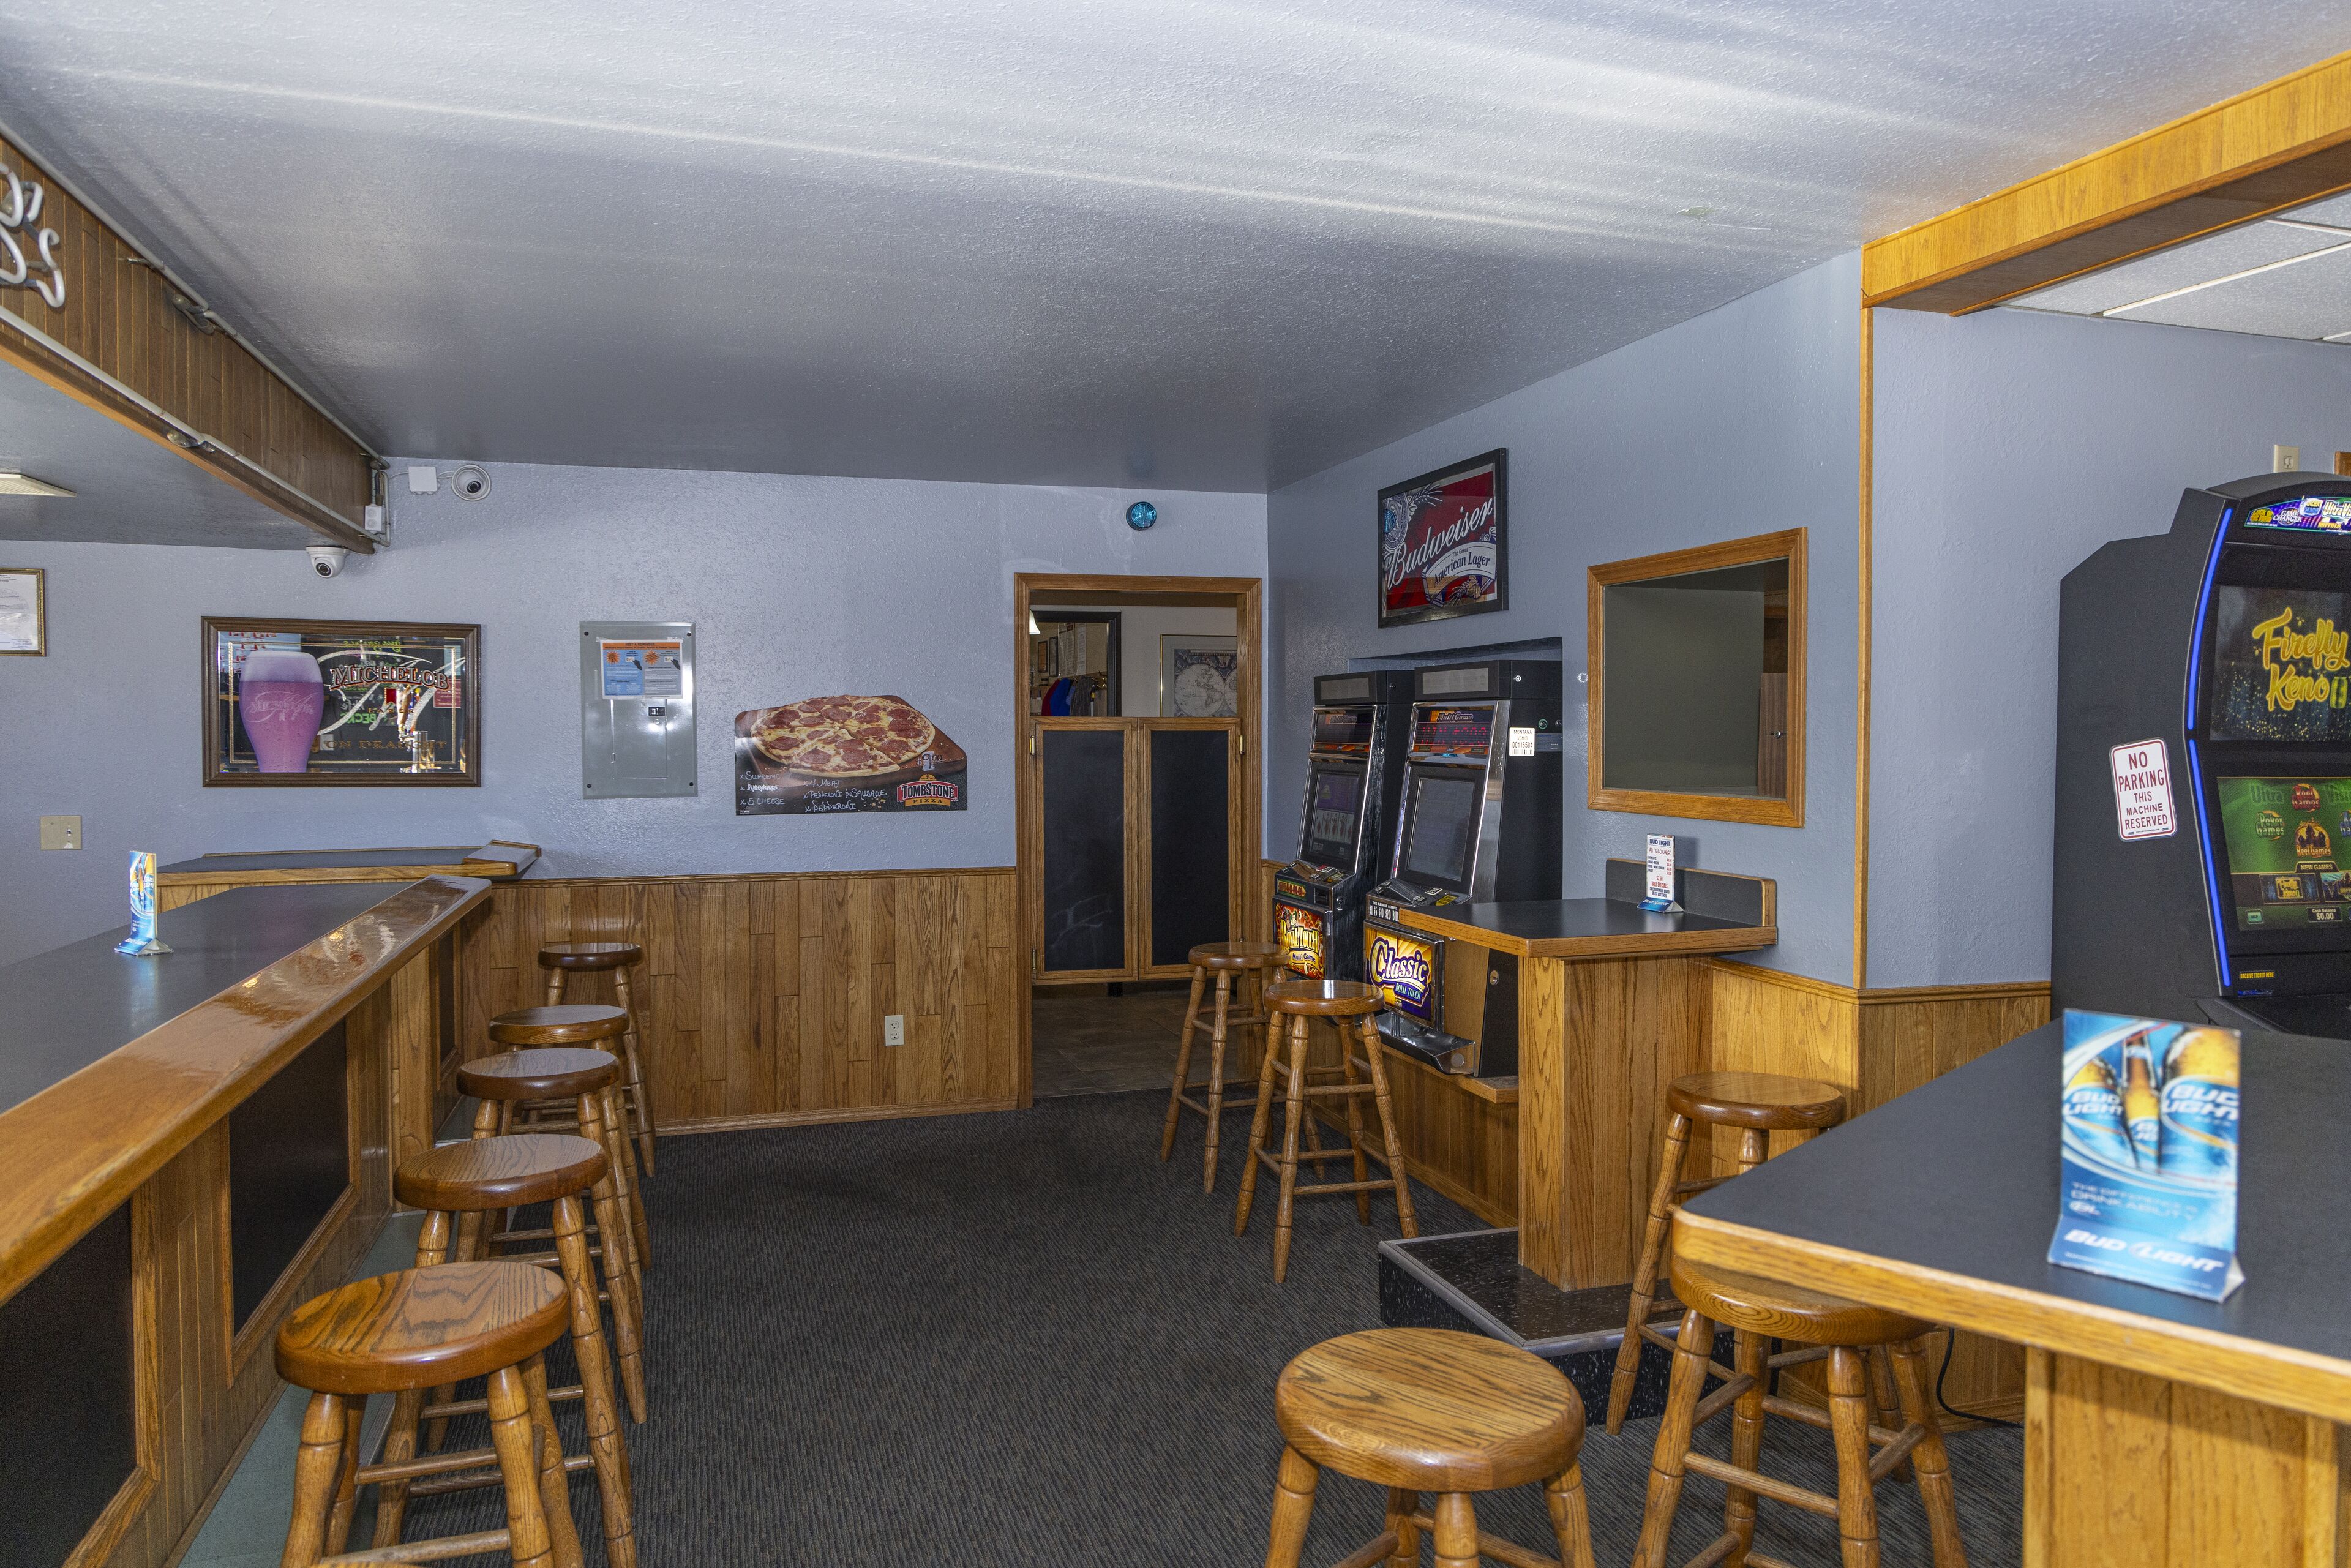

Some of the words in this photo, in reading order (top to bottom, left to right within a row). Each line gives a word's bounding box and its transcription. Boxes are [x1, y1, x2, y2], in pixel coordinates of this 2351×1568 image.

[1383, 497, 1493, 590] Budweiser
[1458, 546, 1469, 556] Great
[1434, 556, 1467, 585] American
[1468, 552, 1490, 568] Lager
[2252, 607, 2350, 672] Firefly
[329, 664, 449, 690] MICHELOB
[2266, 662, 2330, 712] Keno
[1438, 713, 1454, 721] Multi
[1455, 713, 1473, 721] Game
[2128, 751, 2148, 770] NO
[2118, 769, 2164, 792] PARKING
[901, 782, 955, 799] TOMBSTONE
[2134, 791, 2152, 804] THIS
[812, 800, 857, 813] PEPPERONI
[2126, 803, 2163, 816] MACHINE
[2124, 814, 2168, 830] RESERVED
[2259, 812, 2284, 827] Poker
[2256, 823, 2285, 837] Games
[2296, 844, 2310, 857] Reel
[2310, 844, 2331, 858] Games
[1373, 906, 1378, 917] $5
[1280, 919, 1299, 950] ROYAL
[1299, 926, 1318, 953] TOUCH
[1303, 953, 1316, 963] Game
[1371, 940, 1427, 983] Classic
[1396, 982, 1407, 995] ROYAL
[1408, 987, 1421, 1000] TOUCH
[2072, 1090, 2121, 1105] BUD
[2064, 1228, 2128, 1251] BUD
[2137, 1243, 2225, 1272] LIGHT
